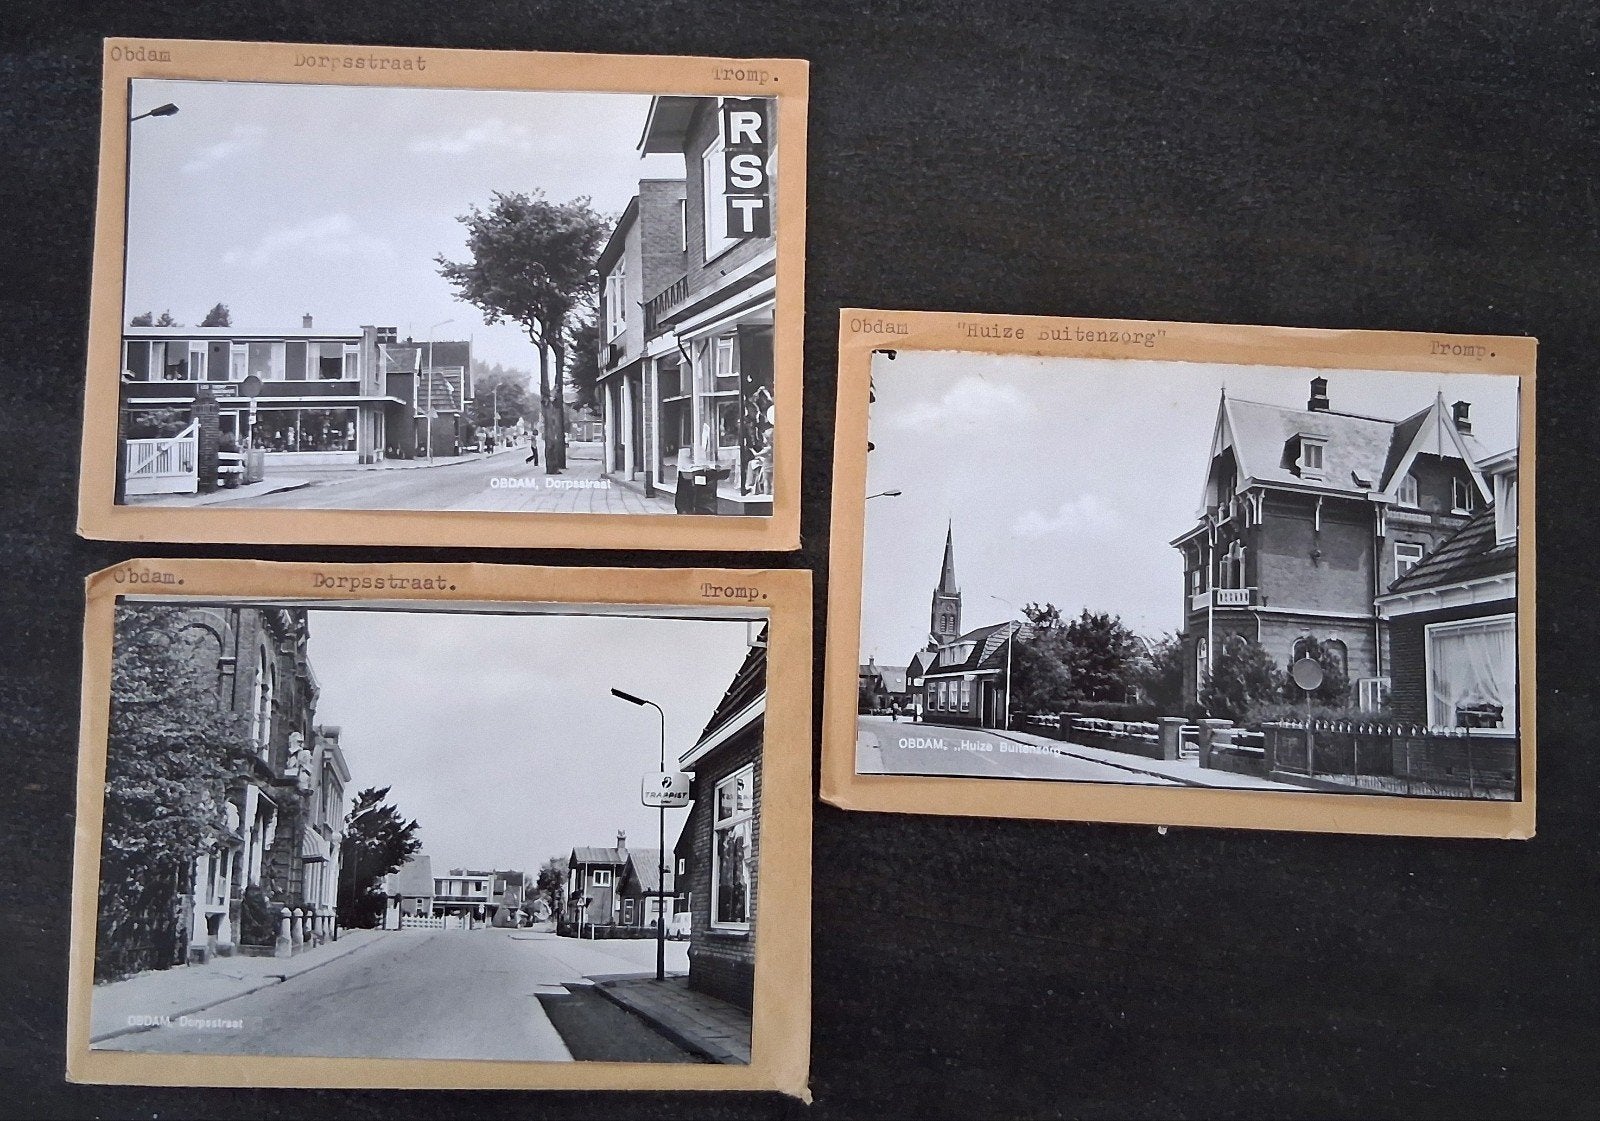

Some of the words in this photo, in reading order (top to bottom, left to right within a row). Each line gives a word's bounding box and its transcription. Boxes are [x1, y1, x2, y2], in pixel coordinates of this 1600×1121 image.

[110, 46, 171, 62] Obdam
[712, 67, 779, 86] Tromp.
[850, 319, 909, 335] Obdam
[957, 323, 1025, 340] "Huize
[1430, 340, 1496, 361] Tromp.
[490, 477, 539, 490] OBDAM,
[545, 477, 611, 490] Dorpsstraat
[114, 568, 185, 585] Obdam.
[313, 572, 456, 593] Dorpsstraat.
[701, 582, 768, 602] Tromp.
